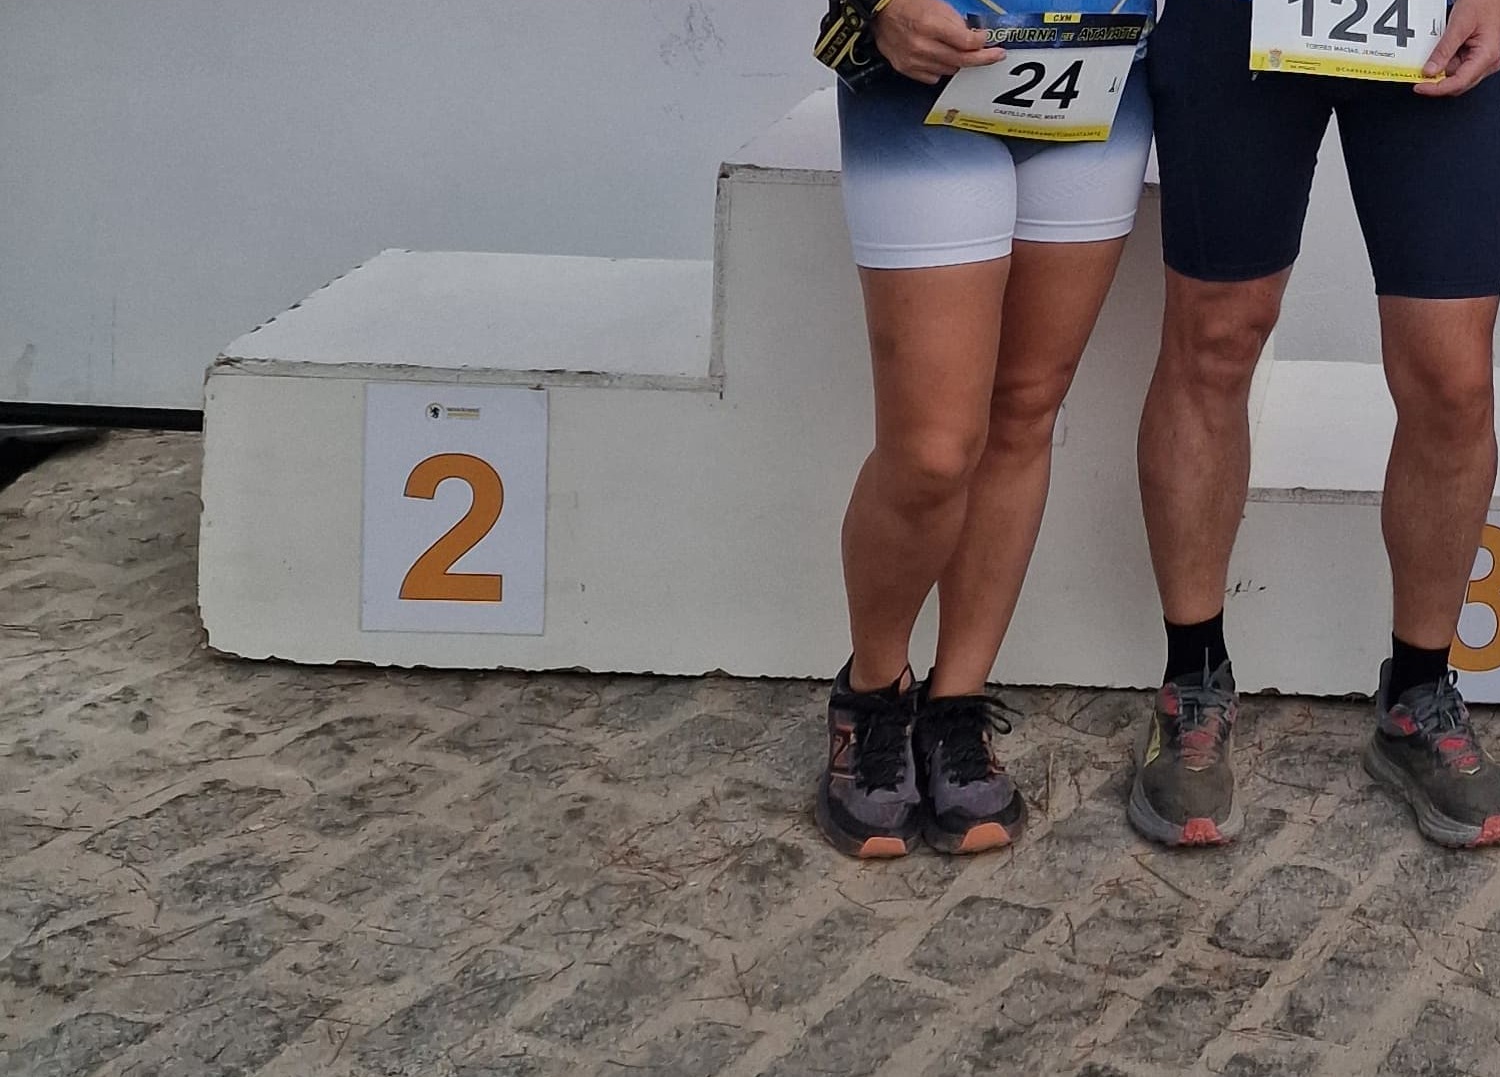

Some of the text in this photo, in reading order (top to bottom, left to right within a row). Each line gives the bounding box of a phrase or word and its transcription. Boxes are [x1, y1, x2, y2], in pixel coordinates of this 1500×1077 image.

[1079, 27, 1141, 41] ATAJATE
[992, 60, 1083, 109] 24
[398, 453, 504, 601] 2
